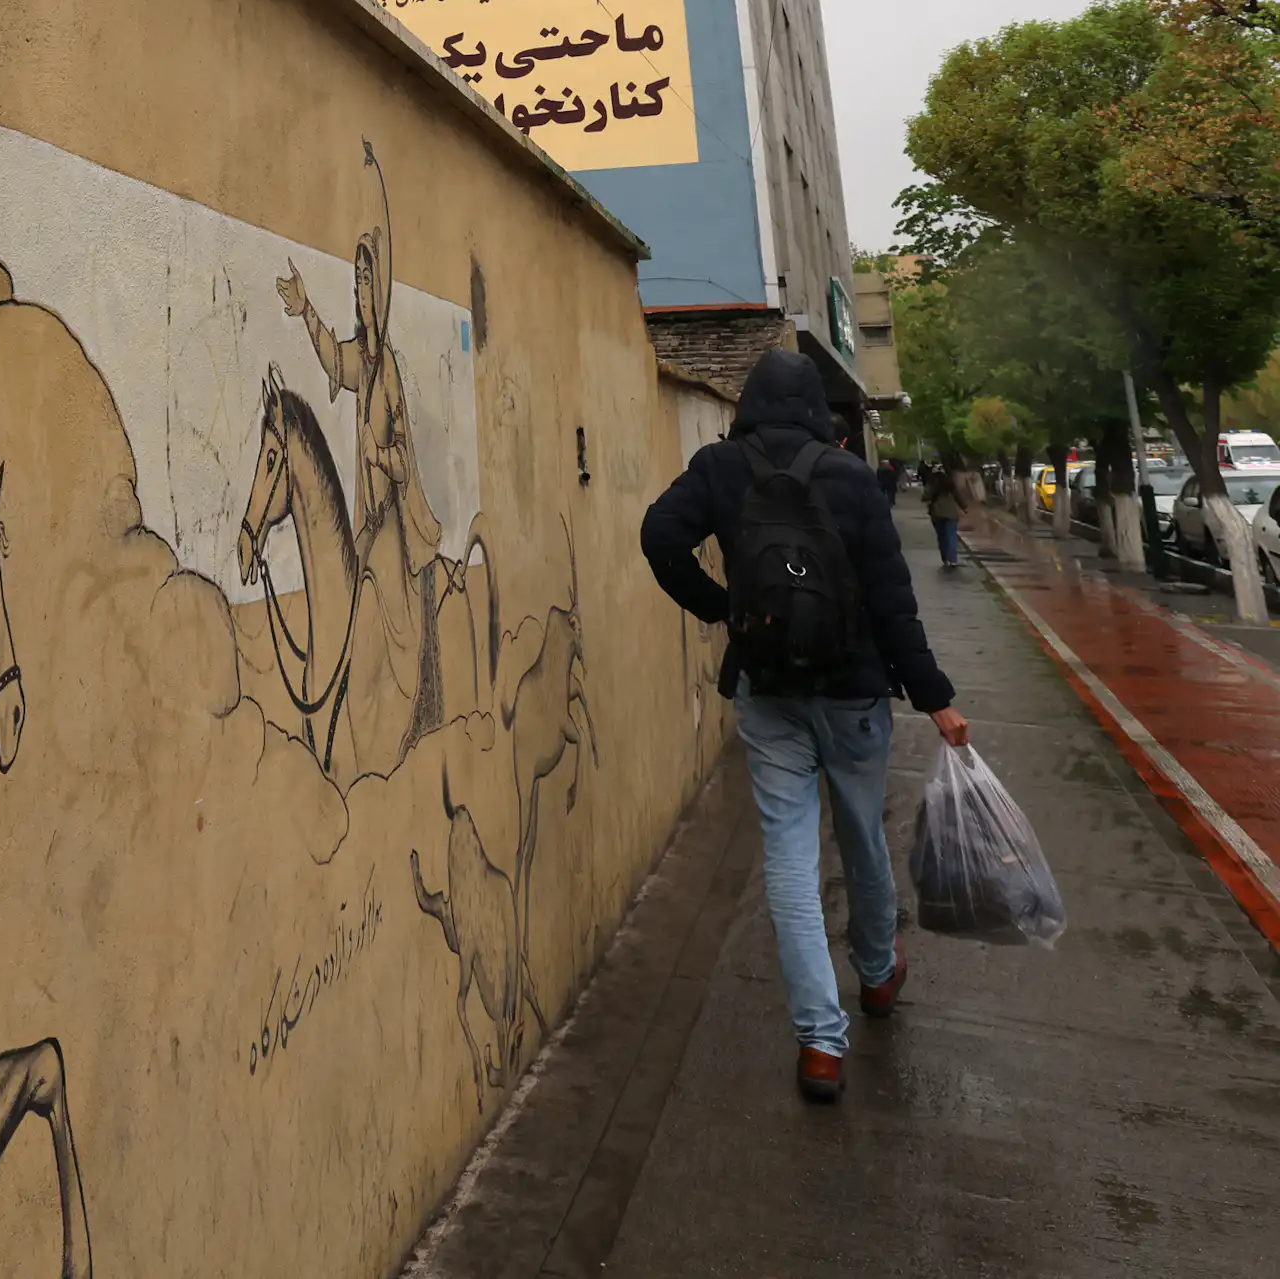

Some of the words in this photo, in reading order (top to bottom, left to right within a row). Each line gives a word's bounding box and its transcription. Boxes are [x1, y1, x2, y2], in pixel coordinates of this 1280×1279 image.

[495, 26, 610, 79] حتی
[615, 13, 664, 52] ما
[494, 84, 586, 136] نخوا
[583, 76, 670, 133] کنار
